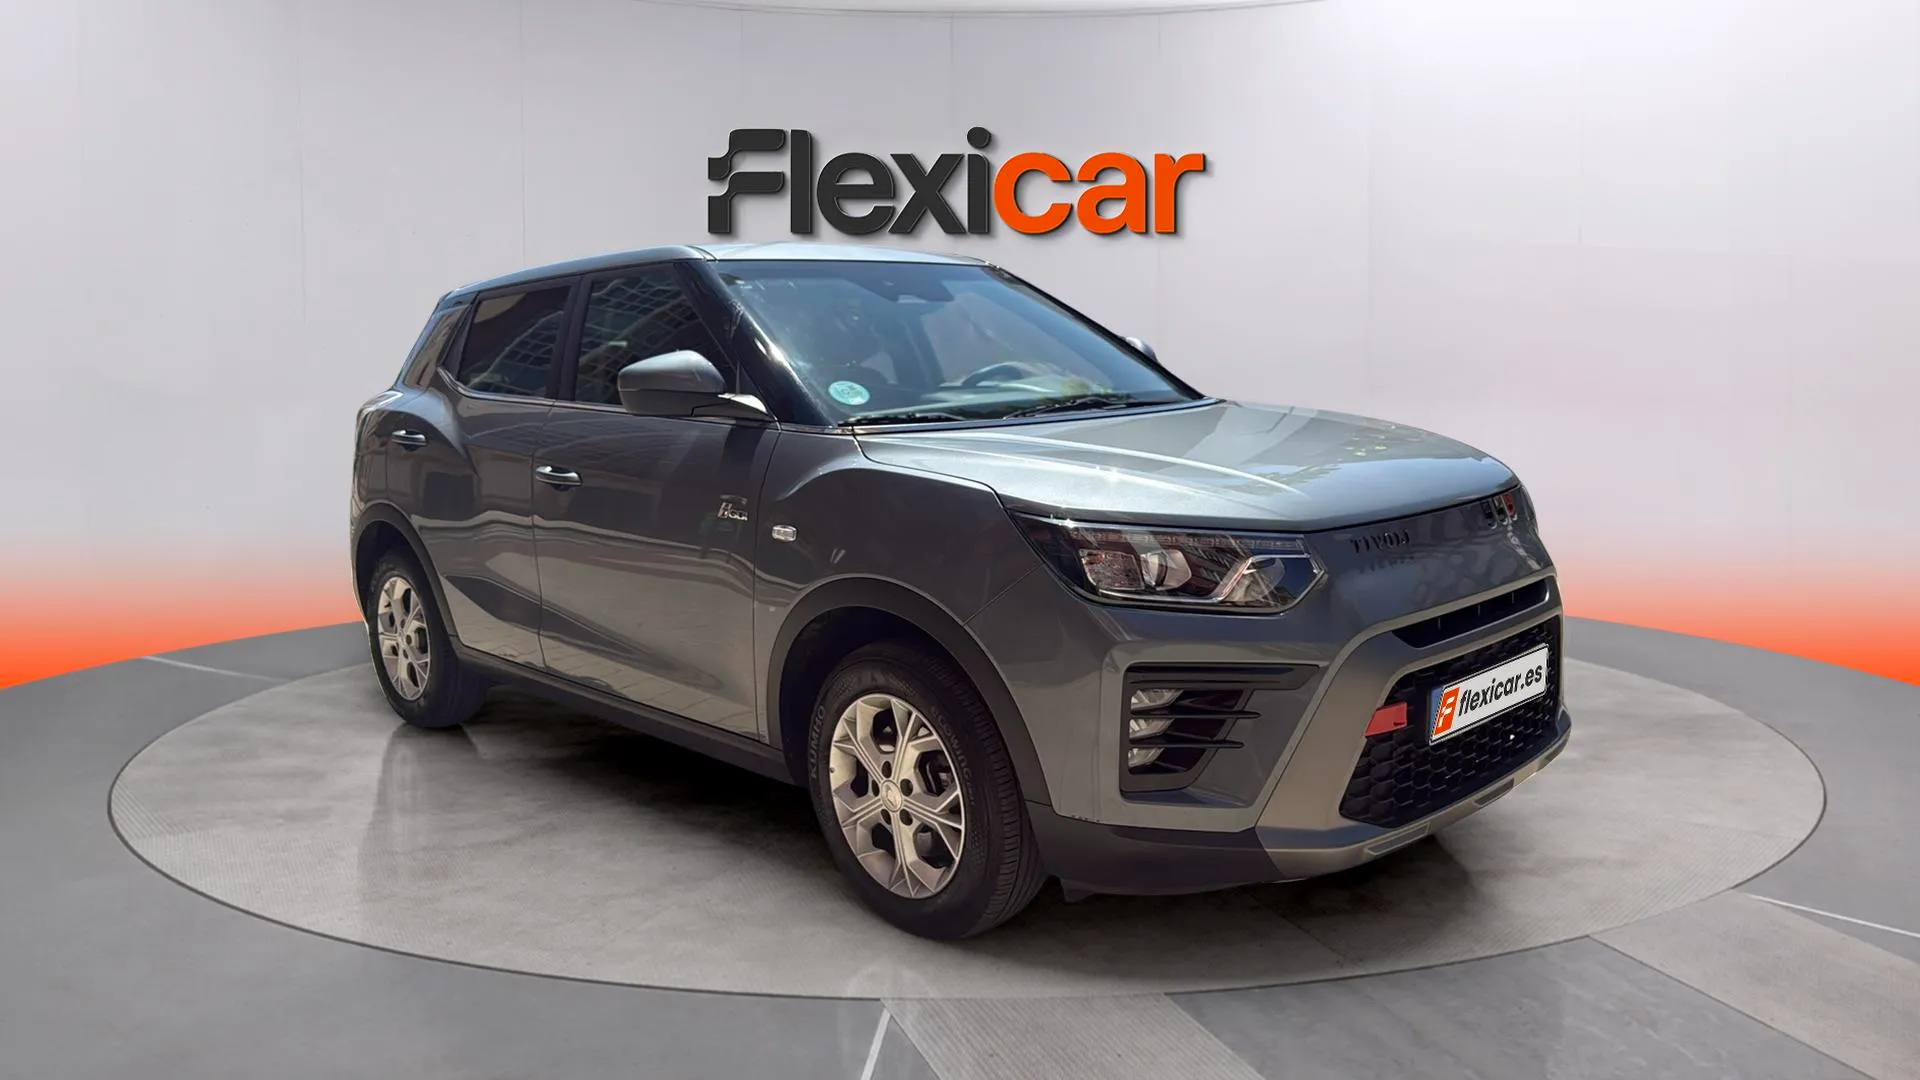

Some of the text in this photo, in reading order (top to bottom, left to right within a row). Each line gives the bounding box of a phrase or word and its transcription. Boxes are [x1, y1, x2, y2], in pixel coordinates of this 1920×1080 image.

[708, 126, 1205, 235] Flexicar
[1458, 664, 1543, 717] flexicar.es
[809, 704, 827, 779] KUMHO
